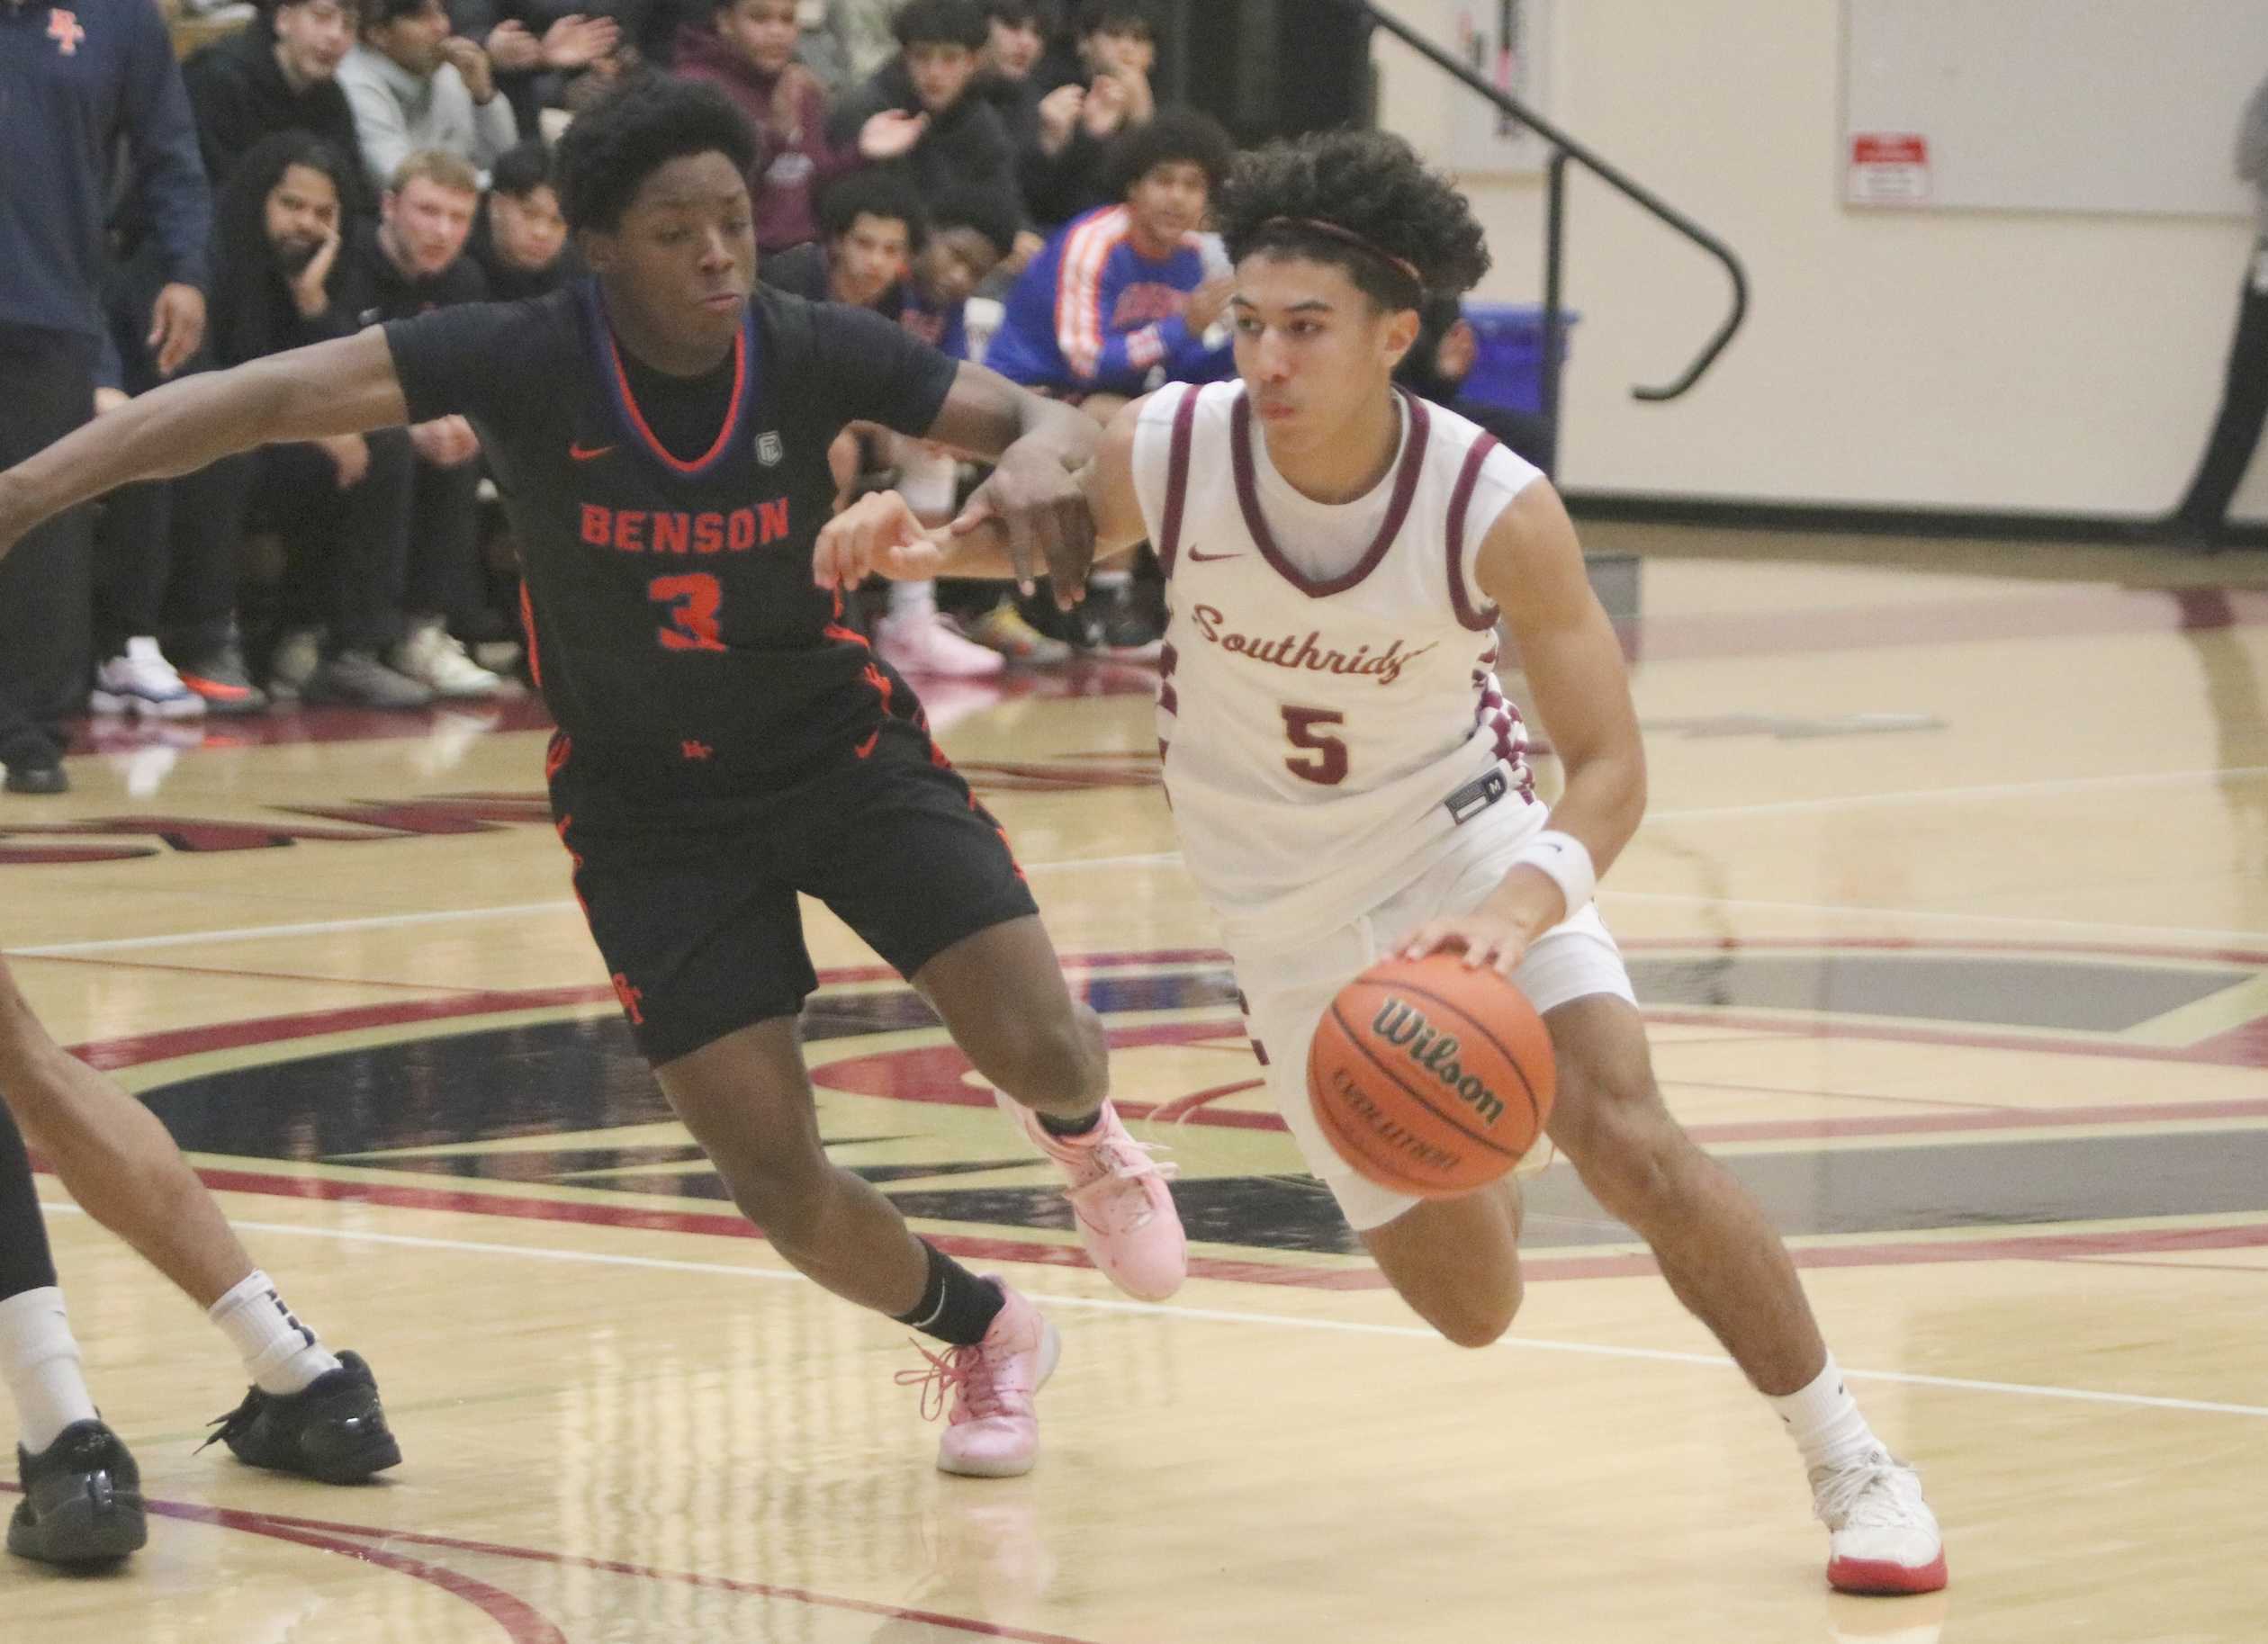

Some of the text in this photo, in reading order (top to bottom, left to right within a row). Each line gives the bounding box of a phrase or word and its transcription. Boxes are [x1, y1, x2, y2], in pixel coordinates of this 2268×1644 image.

[580, 497, 790, 554] BENSON
[648, 570, 728, 651] 3
[1279, 703, 1350, 786] 5
[1488, 778, 1502, 795] M
[1372, 993, 1506, 1126] Wilson
